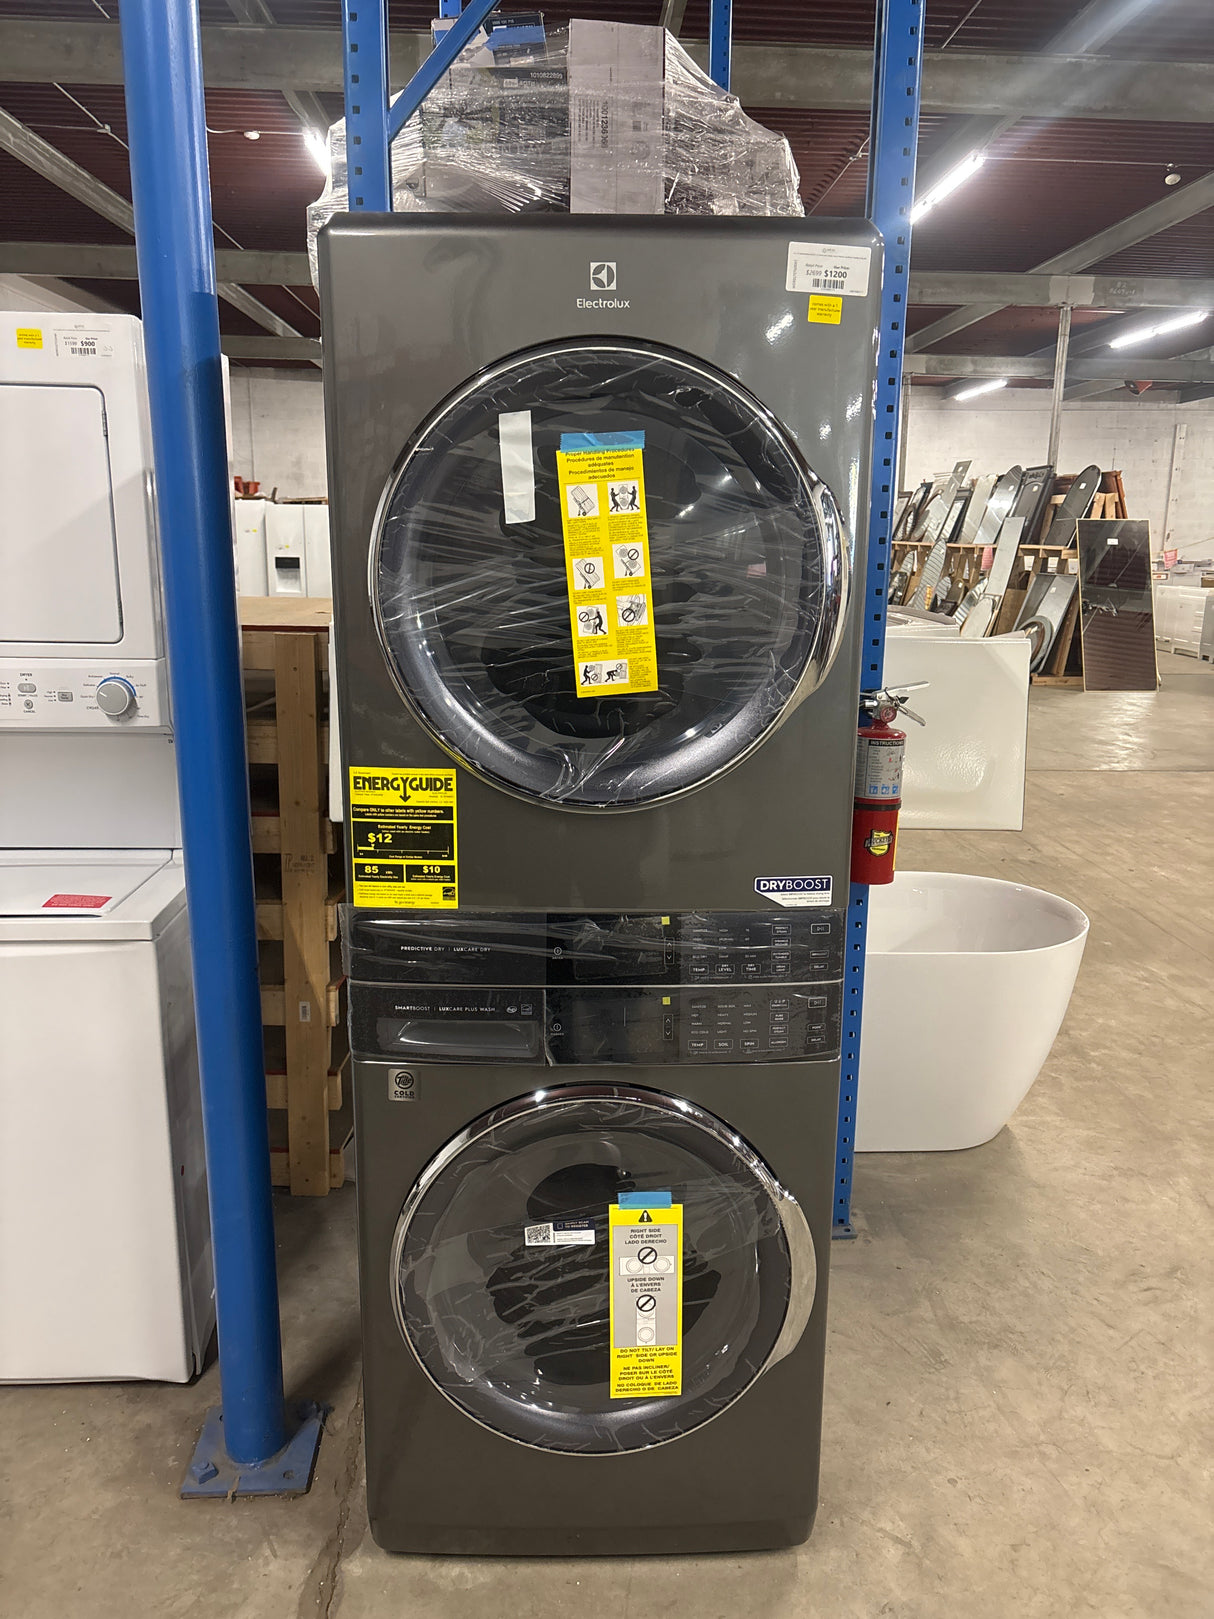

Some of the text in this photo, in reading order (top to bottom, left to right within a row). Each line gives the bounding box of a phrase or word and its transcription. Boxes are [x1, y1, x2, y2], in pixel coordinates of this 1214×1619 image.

[824, 270, 847, 278] $1200
[576, 298, 630, 308] Electrolux
[353, 776, 453, 792] ENERGYGUIDE
[368, 833, 392, 843] $12
[761, 879, 828, 890] DRYBOOST
